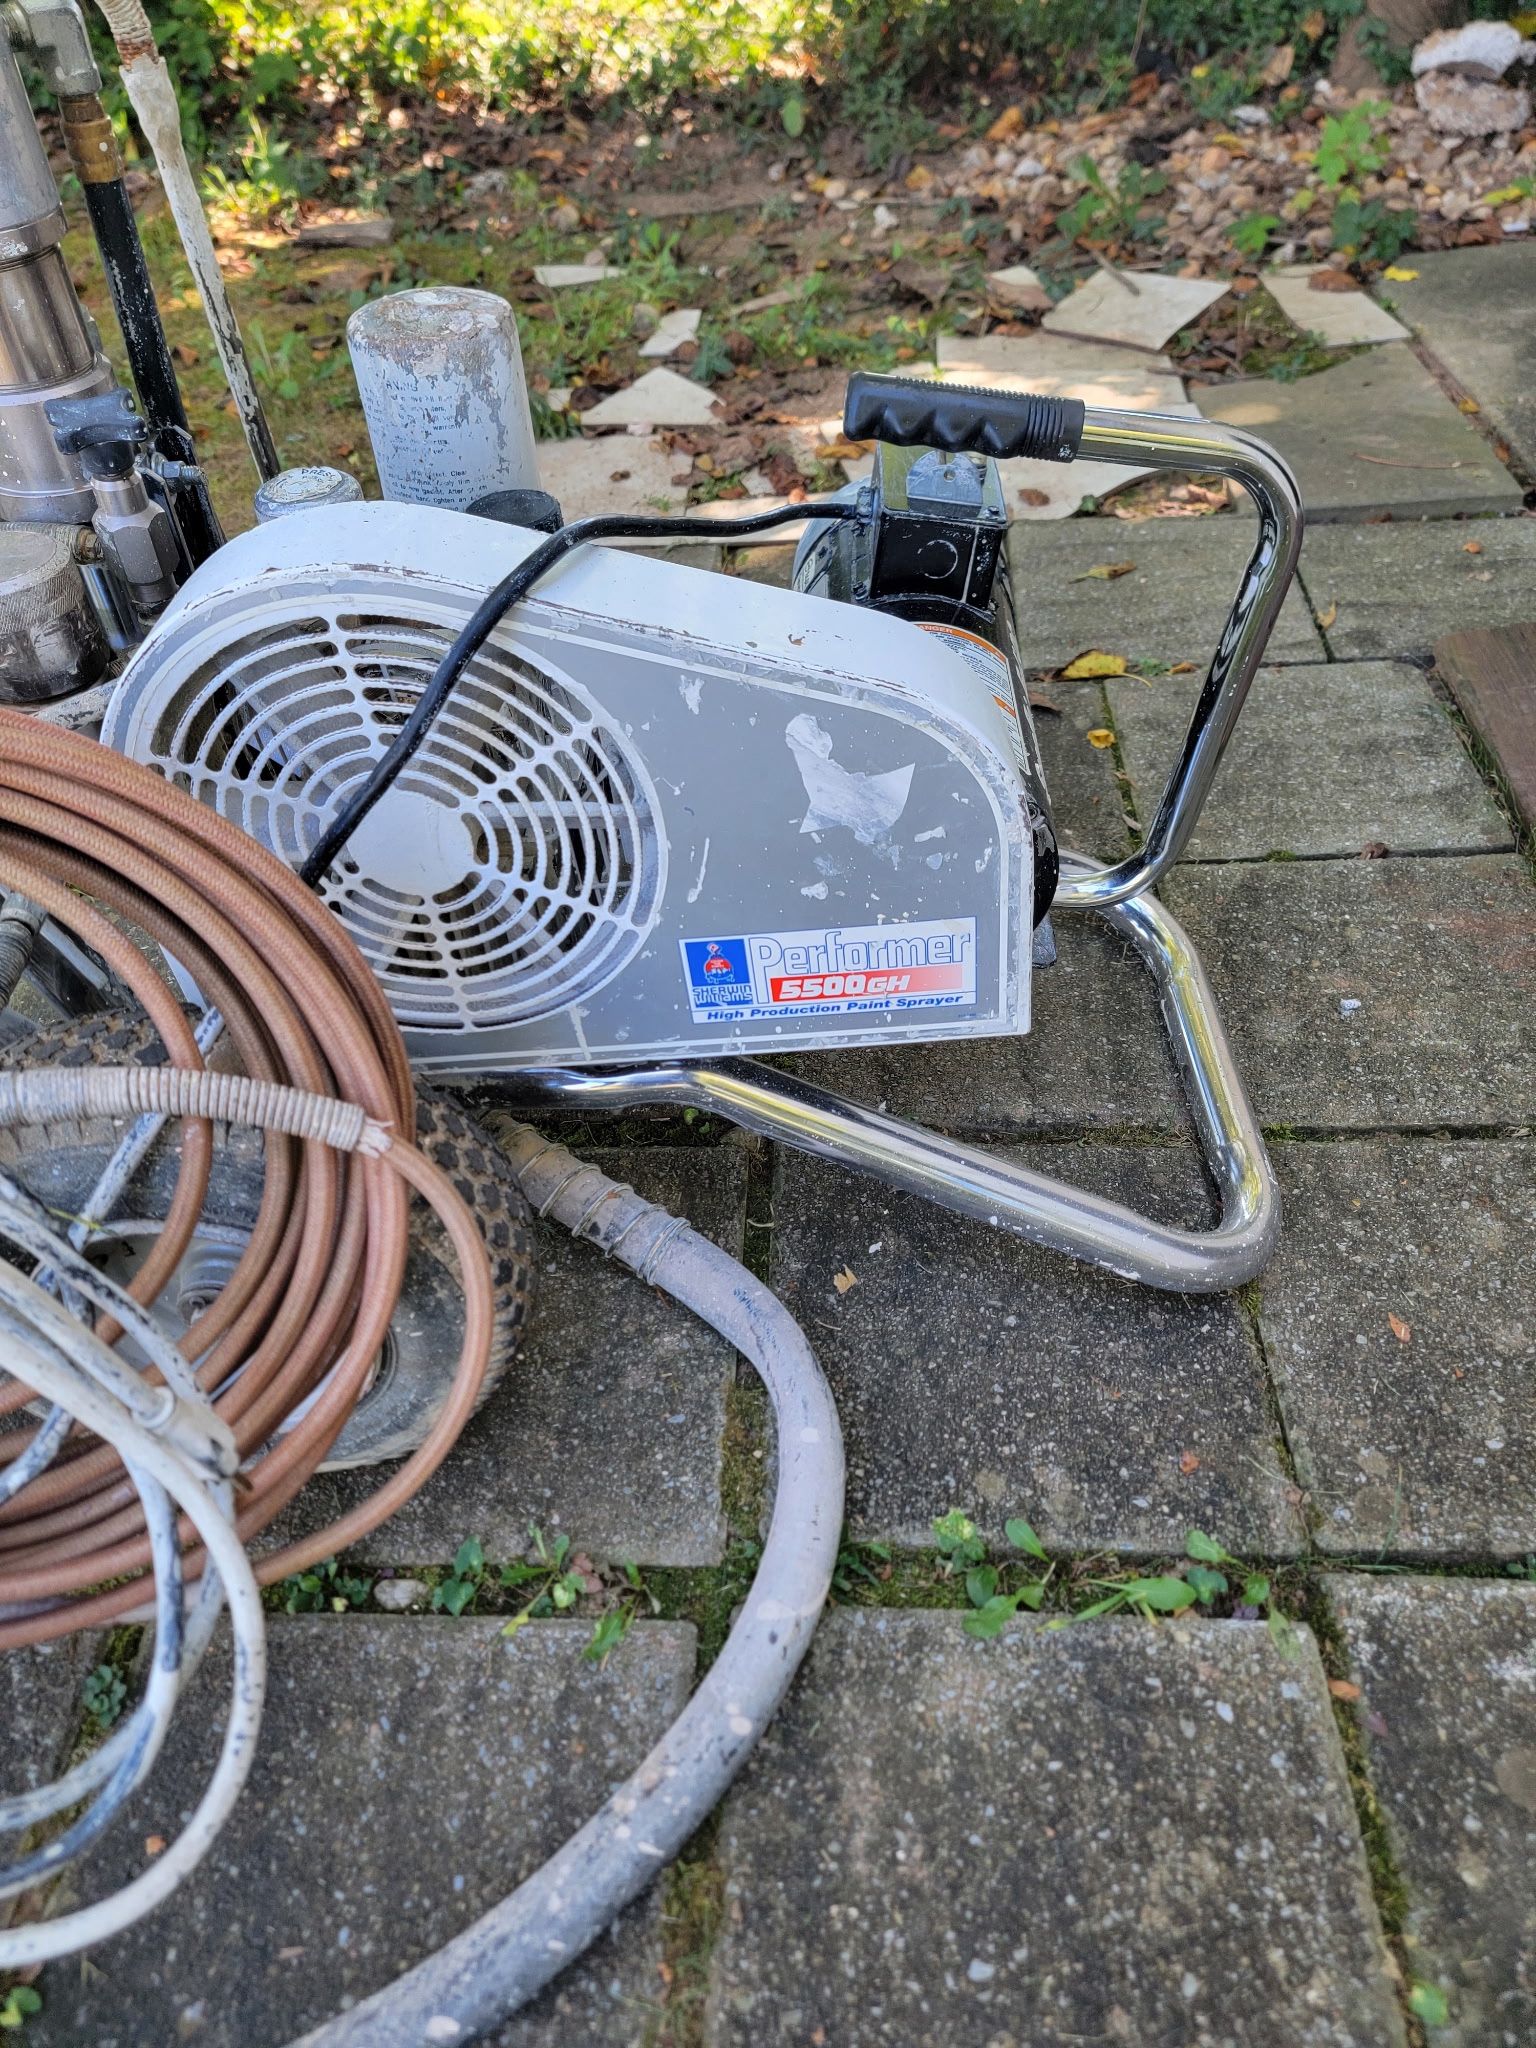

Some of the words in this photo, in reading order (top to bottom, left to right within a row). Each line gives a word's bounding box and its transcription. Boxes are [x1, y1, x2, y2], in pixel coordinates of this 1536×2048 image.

[749, 931, 971, 1004] Performer
[707, 1010, 744, 1021] High
[750, 1004, 841, 1018] Production
[847, 999, 891, 1011] Paint
[896, 994, 964, 1009] Sprayer
